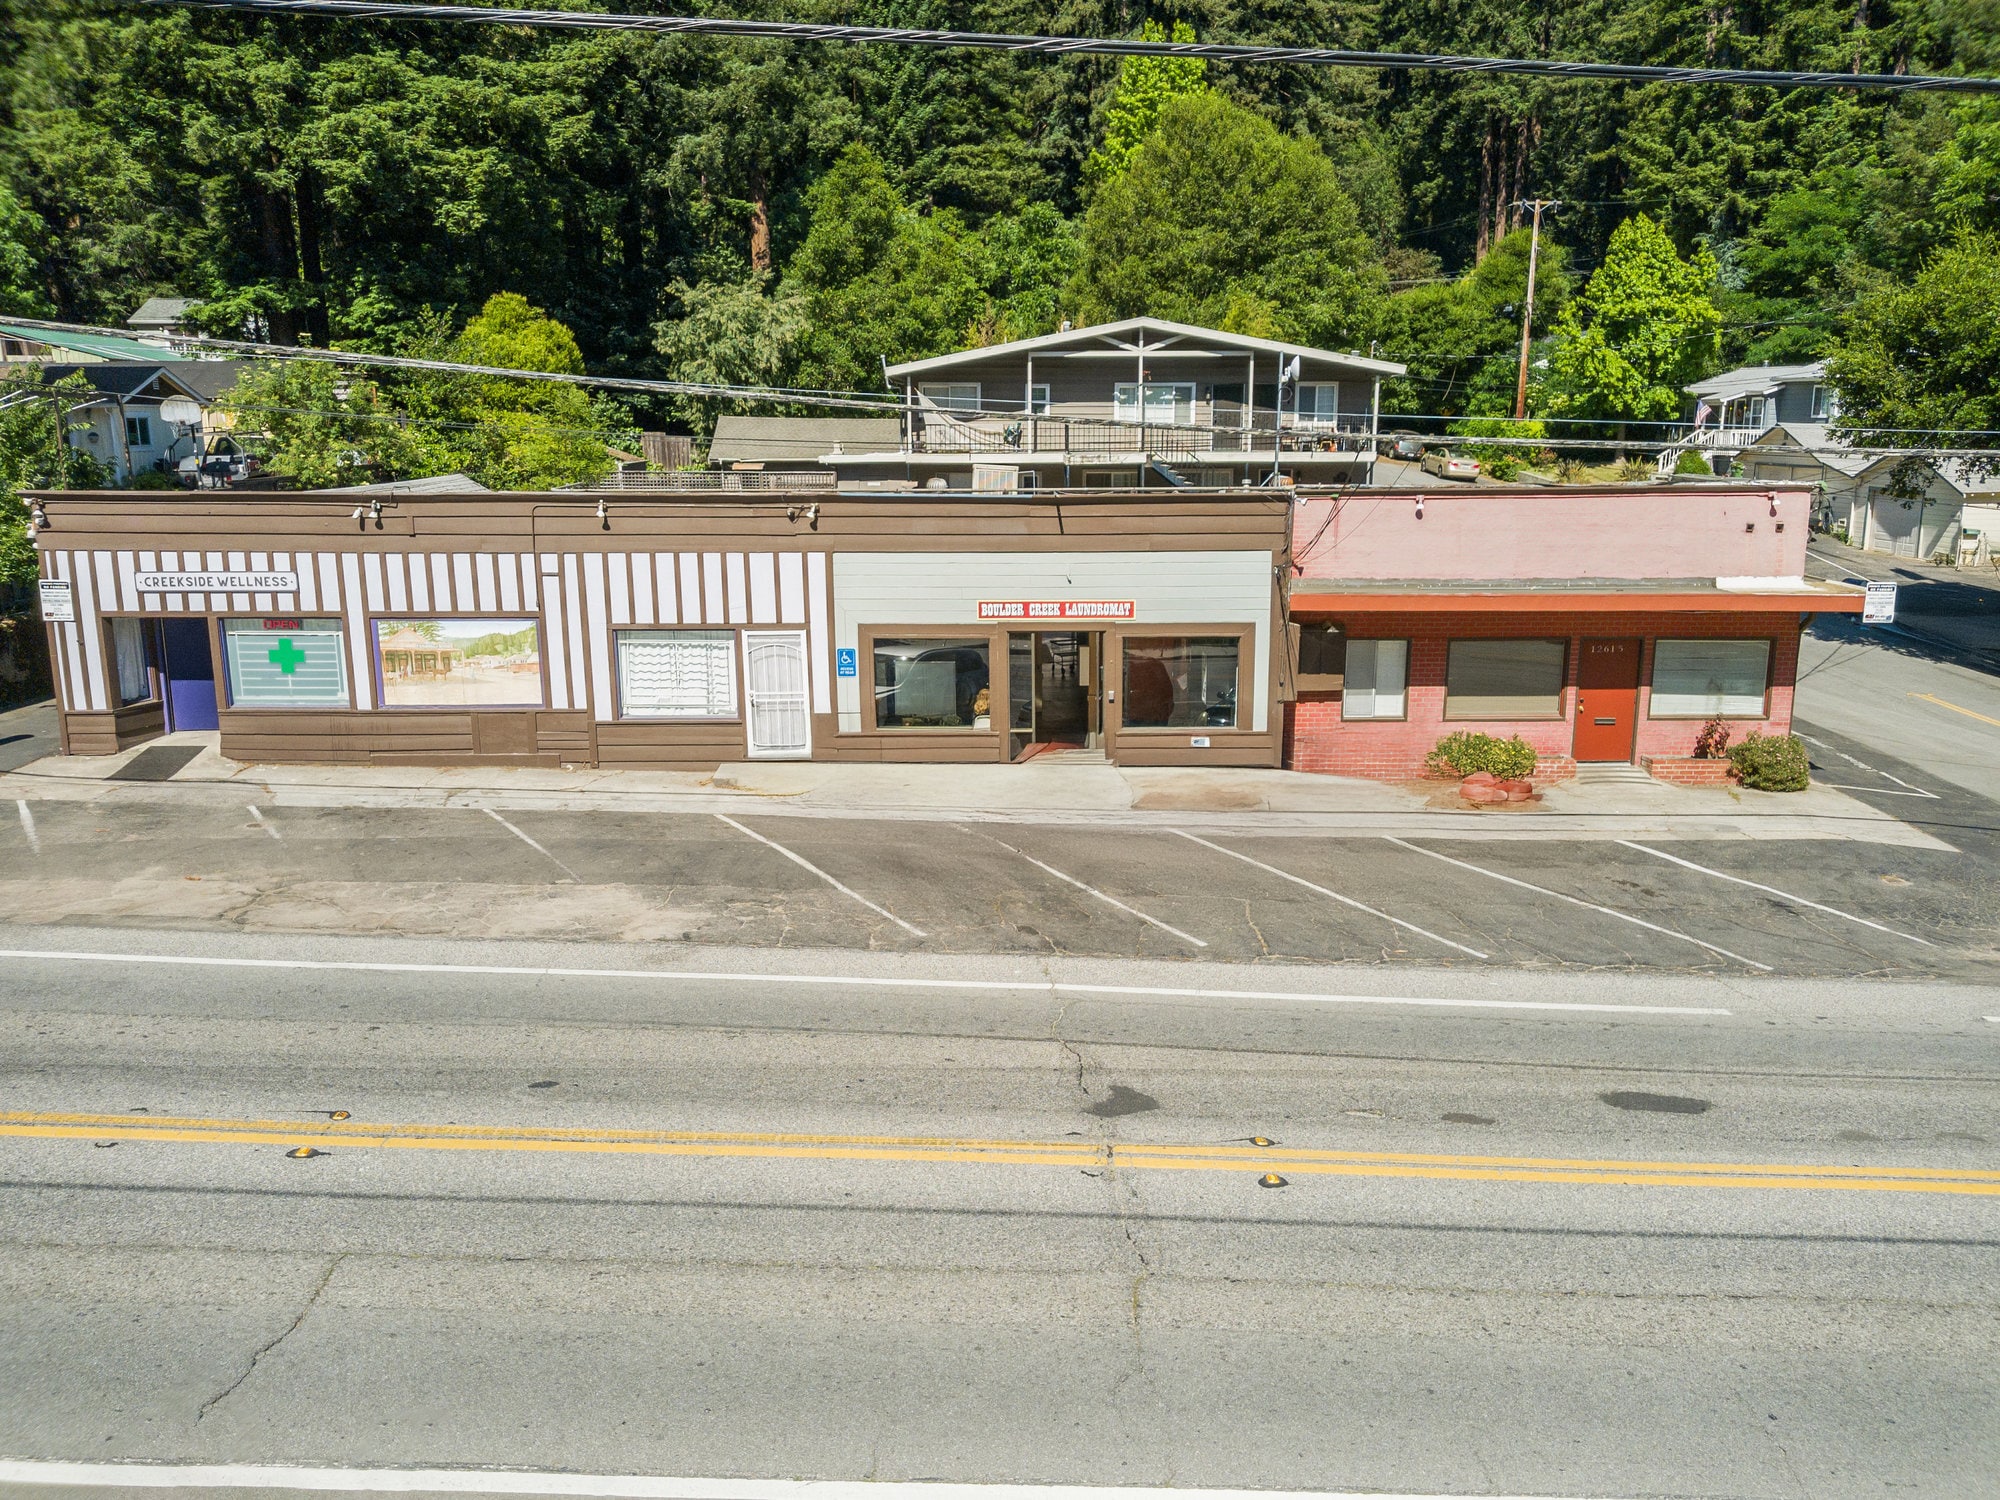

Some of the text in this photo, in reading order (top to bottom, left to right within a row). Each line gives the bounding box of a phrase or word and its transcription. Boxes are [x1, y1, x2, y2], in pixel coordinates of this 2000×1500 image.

[144, 576, 288, 587] CREEKSIDE WELLNESS
[981, 603, 1131, 616] BOULDER CREEK LAUNDROMAT
[262, 619, 299, 629] OPEN
